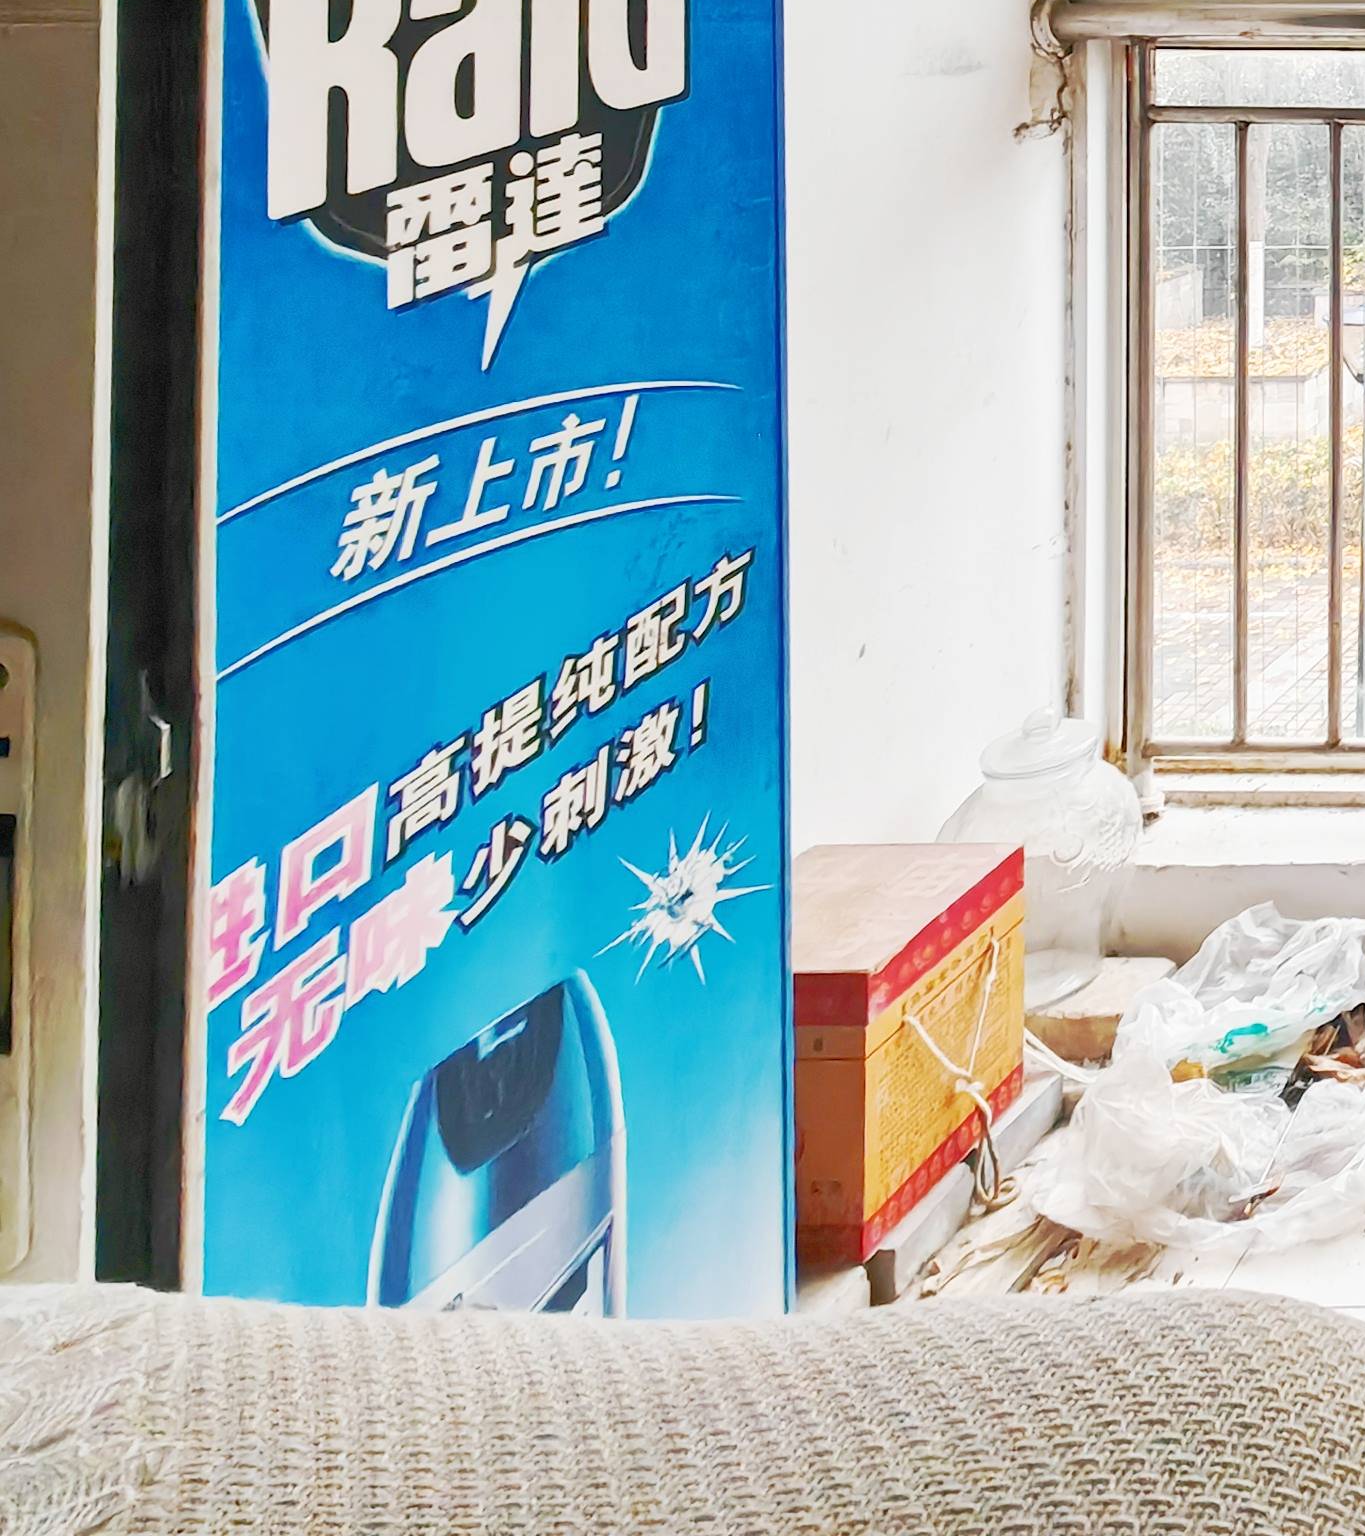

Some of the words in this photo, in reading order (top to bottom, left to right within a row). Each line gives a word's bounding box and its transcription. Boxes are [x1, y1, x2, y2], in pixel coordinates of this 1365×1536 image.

[386, 132, 604, 312] 雷達
[330, 394, 640, 581] 新上市!
[218, 681, 709, 1126] 无味少刺激!
